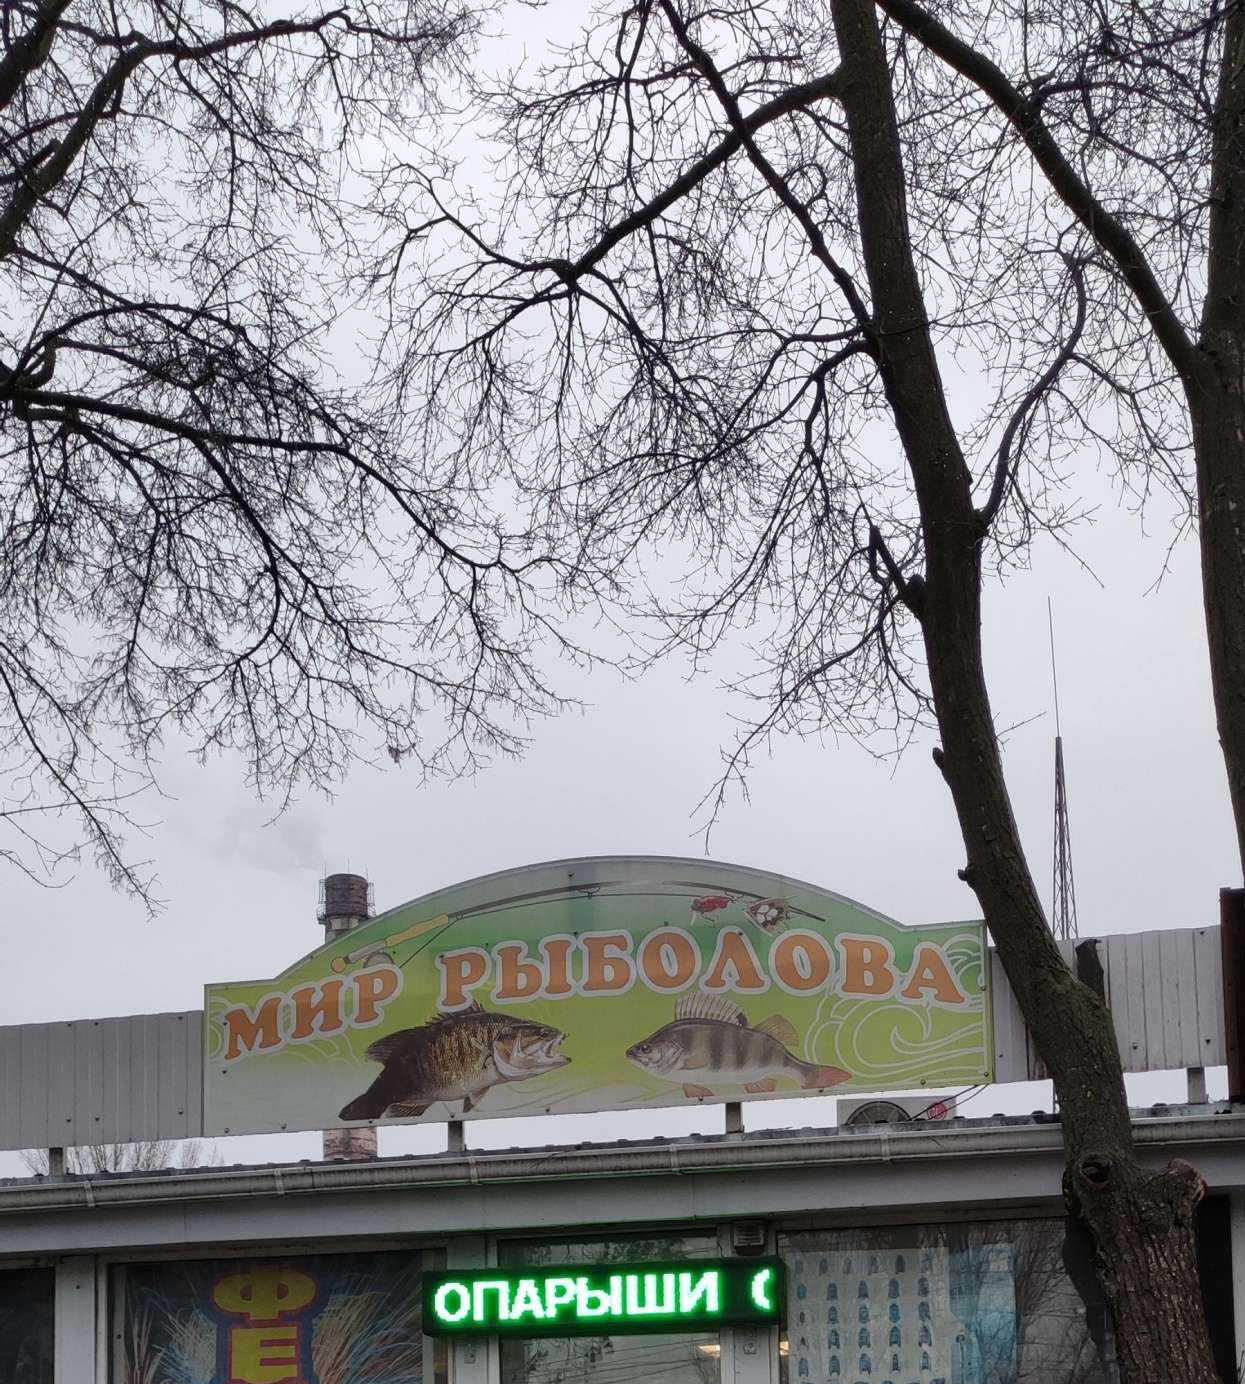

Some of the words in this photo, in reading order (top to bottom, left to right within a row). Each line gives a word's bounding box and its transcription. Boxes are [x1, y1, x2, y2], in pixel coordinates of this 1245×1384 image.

[223, 966, 400, 1061] МИР
[440, 931, 966, 1007] РЫБОЛОВА
[434, 1271, 719, 1322] ОПАРЫШИ
